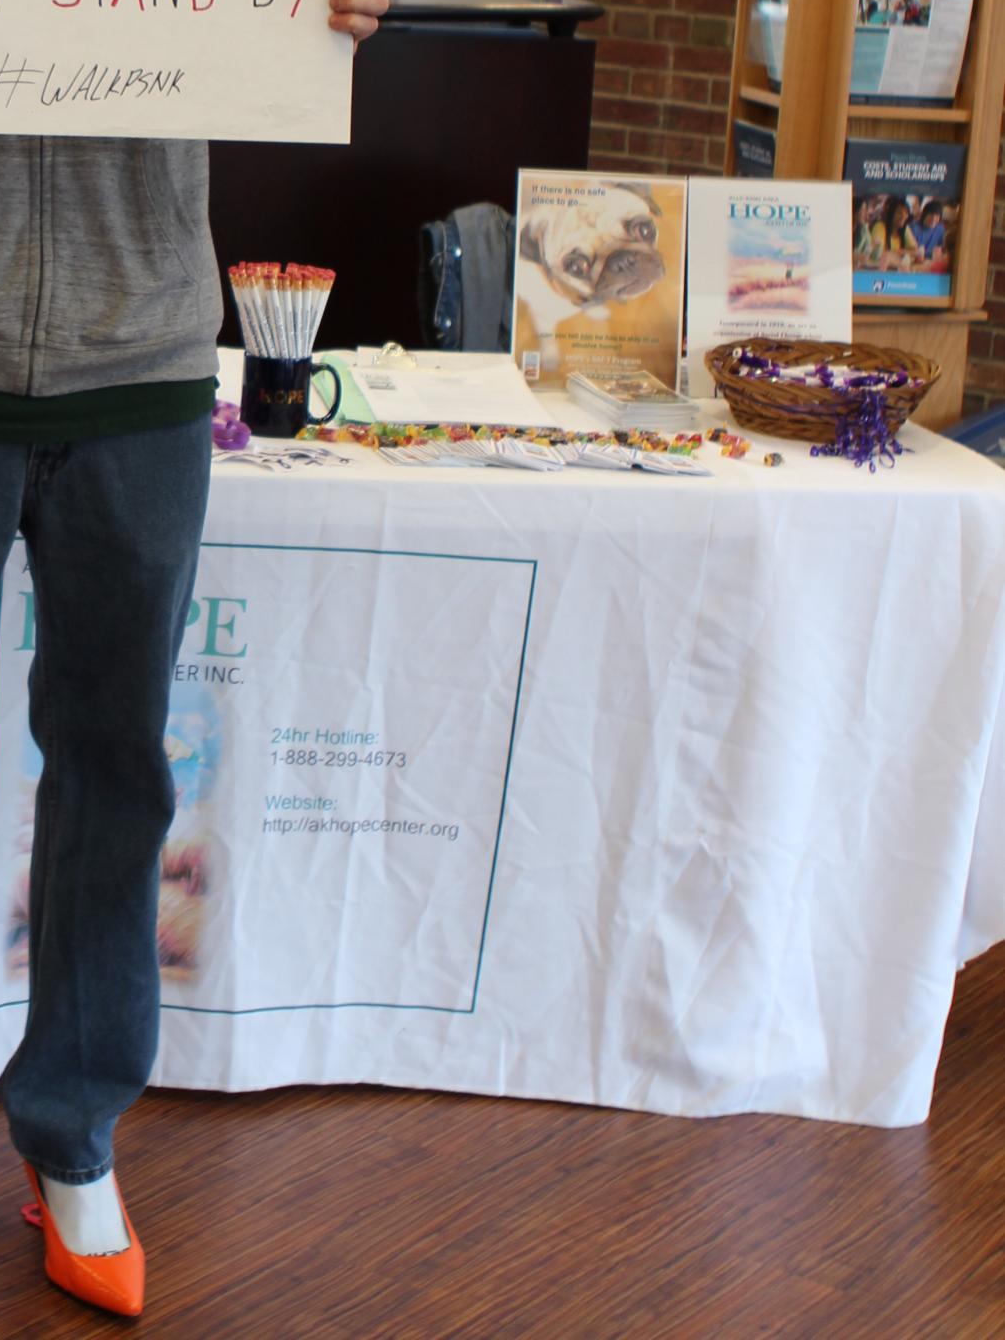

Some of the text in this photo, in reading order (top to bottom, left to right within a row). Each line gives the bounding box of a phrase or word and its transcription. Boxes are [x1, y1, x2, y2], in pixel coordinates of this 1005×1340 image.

[864, 170, 884, 179] AND
[541, 185, 563, 195] there
[565, 187, 572, 195] is
[587, 188, 606, 197] safe
[531, 196, 555, 207] place
[556, 197, 566, 206] to
[728, 203, 811, 221] HOPE
[204, 664, 245, 685] INC.
[270, 727, 380, 746] 24hr Hotline:
[270, 749, 407, 769] 1-888-299-4673
[264, 794, 338, 811] Website:
[261, 817, 460, 841] http://akhopecenter.org
